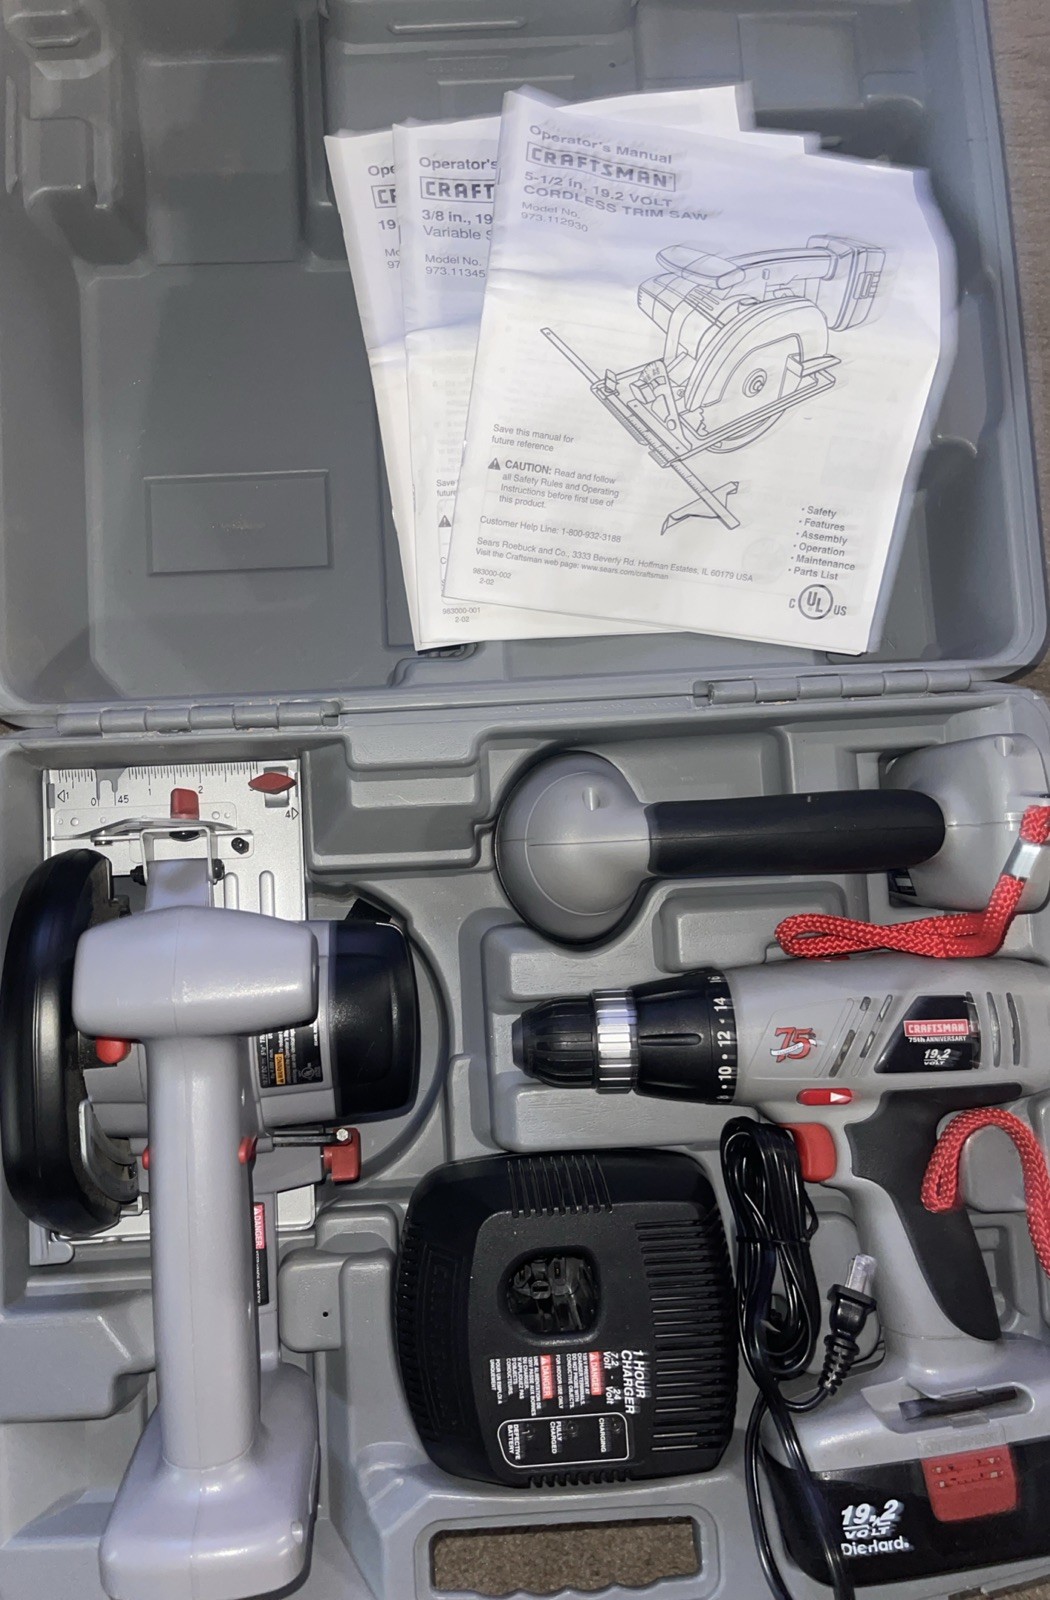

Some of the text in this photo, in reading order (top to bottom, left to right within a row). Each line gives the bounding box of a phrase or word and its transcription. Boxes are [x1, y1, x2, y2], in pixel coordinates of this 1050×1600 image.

[529, 124, 672, 164] Operator's Manual
[531, 147, 671, 187] CRAFTSMAN
[425, 181, 495, 200] CRAFT
[524, 171, 563, 187] 5-1/2
[594, 185, 624, 202] 19.2
[629, 194, 673, 208] VOLT
[521, 201, 581, 219] Model No.
[523, 185, 708, 221] CORDLESS TRIM SAW
[422, 209, 445, 222] 3/8
[423, 225, 481, 240] Variable
[425, 254, 481, 267] Model No.
[425, 266, 486, 278] 973.11345
[491, 435, 554, 452] future reference
[493, 424, 574, 444] Save this manual for
[505, 460, 616, 485] CAUTION: Read and follow
[436, 479, 456, 488] Save
[502, 473, 620, 499] all Safety Rules and Operating
[499, 495, 546, 509] this product.
[501, 483, 614, 507] Instructions before first use of
[807, 505, 837, 520] Safety
[480, 515, 622, 543] Customer Help Line: 1-800-932-3188
[804, 518, 845, 531] Features
[801, 530, 848, 546] Assembly
[799, 542, 845, 557] Operation
[475, 547, 669, 581] Visit the Craftsman web page: www.sears.com/craftsman
[477, 537, 500, 548] Sears
[502, 541, 536, 553] Roebuck
[538, 546, 553, 556] and
[572, 551, 591, 560] 3333
[593, 554, 622, 566] Beverly
[638, 560, 669, 571] Hoffman
[702, 568, 709, 576] IL
[710, 569, 734, 580] 60179
[736, 572, 753, 582] USA
[796, 554, 856, 571] Maintenance
[794, 566, 838, 580] Parts List
[806, 590, 823, 613] UL
[834, 604, 847, 616] US
[90, 797, 97, 807] 0
[117, 795, 129, 804] 45
[198, 786, 204, 795] 2
[285, 809, 291, 819] 4
[713, 997, 728, 1012] 14
[908, 1023, 965, 1034] CRAFTSMAN
[717, 1030, 731, 1047] 12
[775, 1026, 813, 1063] 75
[924, 1048, 951, 1059] 19.2
[718, 1066, 732, 1081] 10
[542, 1366, 550, 1395] DANGER
[591, 1362, 599, 1392] DANGER
[603, 1351, 614, 1404] Volt Volt
[611, 1353, 621, 1400] 7.2 24
[621, 1350, 635, 1414] CHARGER
[634, 1360, 646, 1398] HOUR
[841, 1499, 899, 1526] 19.2
[845, 1526, 890, 1539] VOLT
